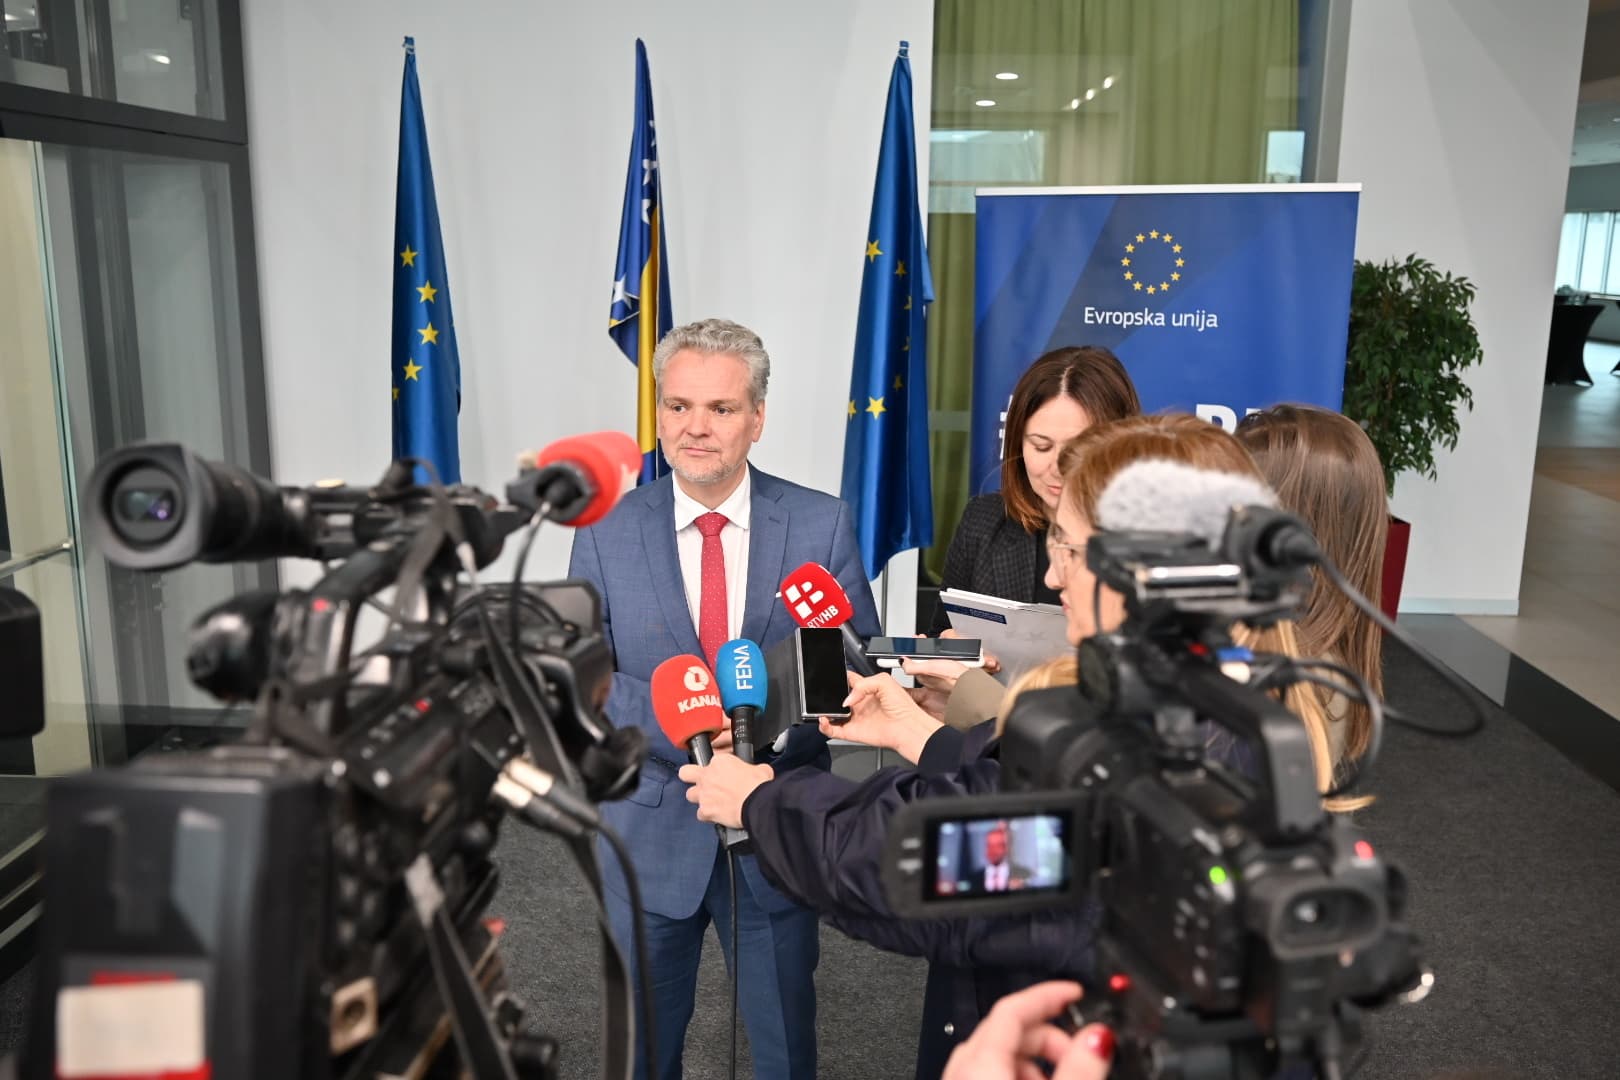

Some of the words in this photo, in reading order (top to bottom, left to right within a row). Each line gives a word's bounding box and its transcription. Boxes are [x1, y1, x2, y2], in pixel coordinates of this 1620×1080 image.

[1084, 306, 1165, 328] Evropska
[1172, 309, 1218, 332] unija
[733, 645, 753, 690] FENA
